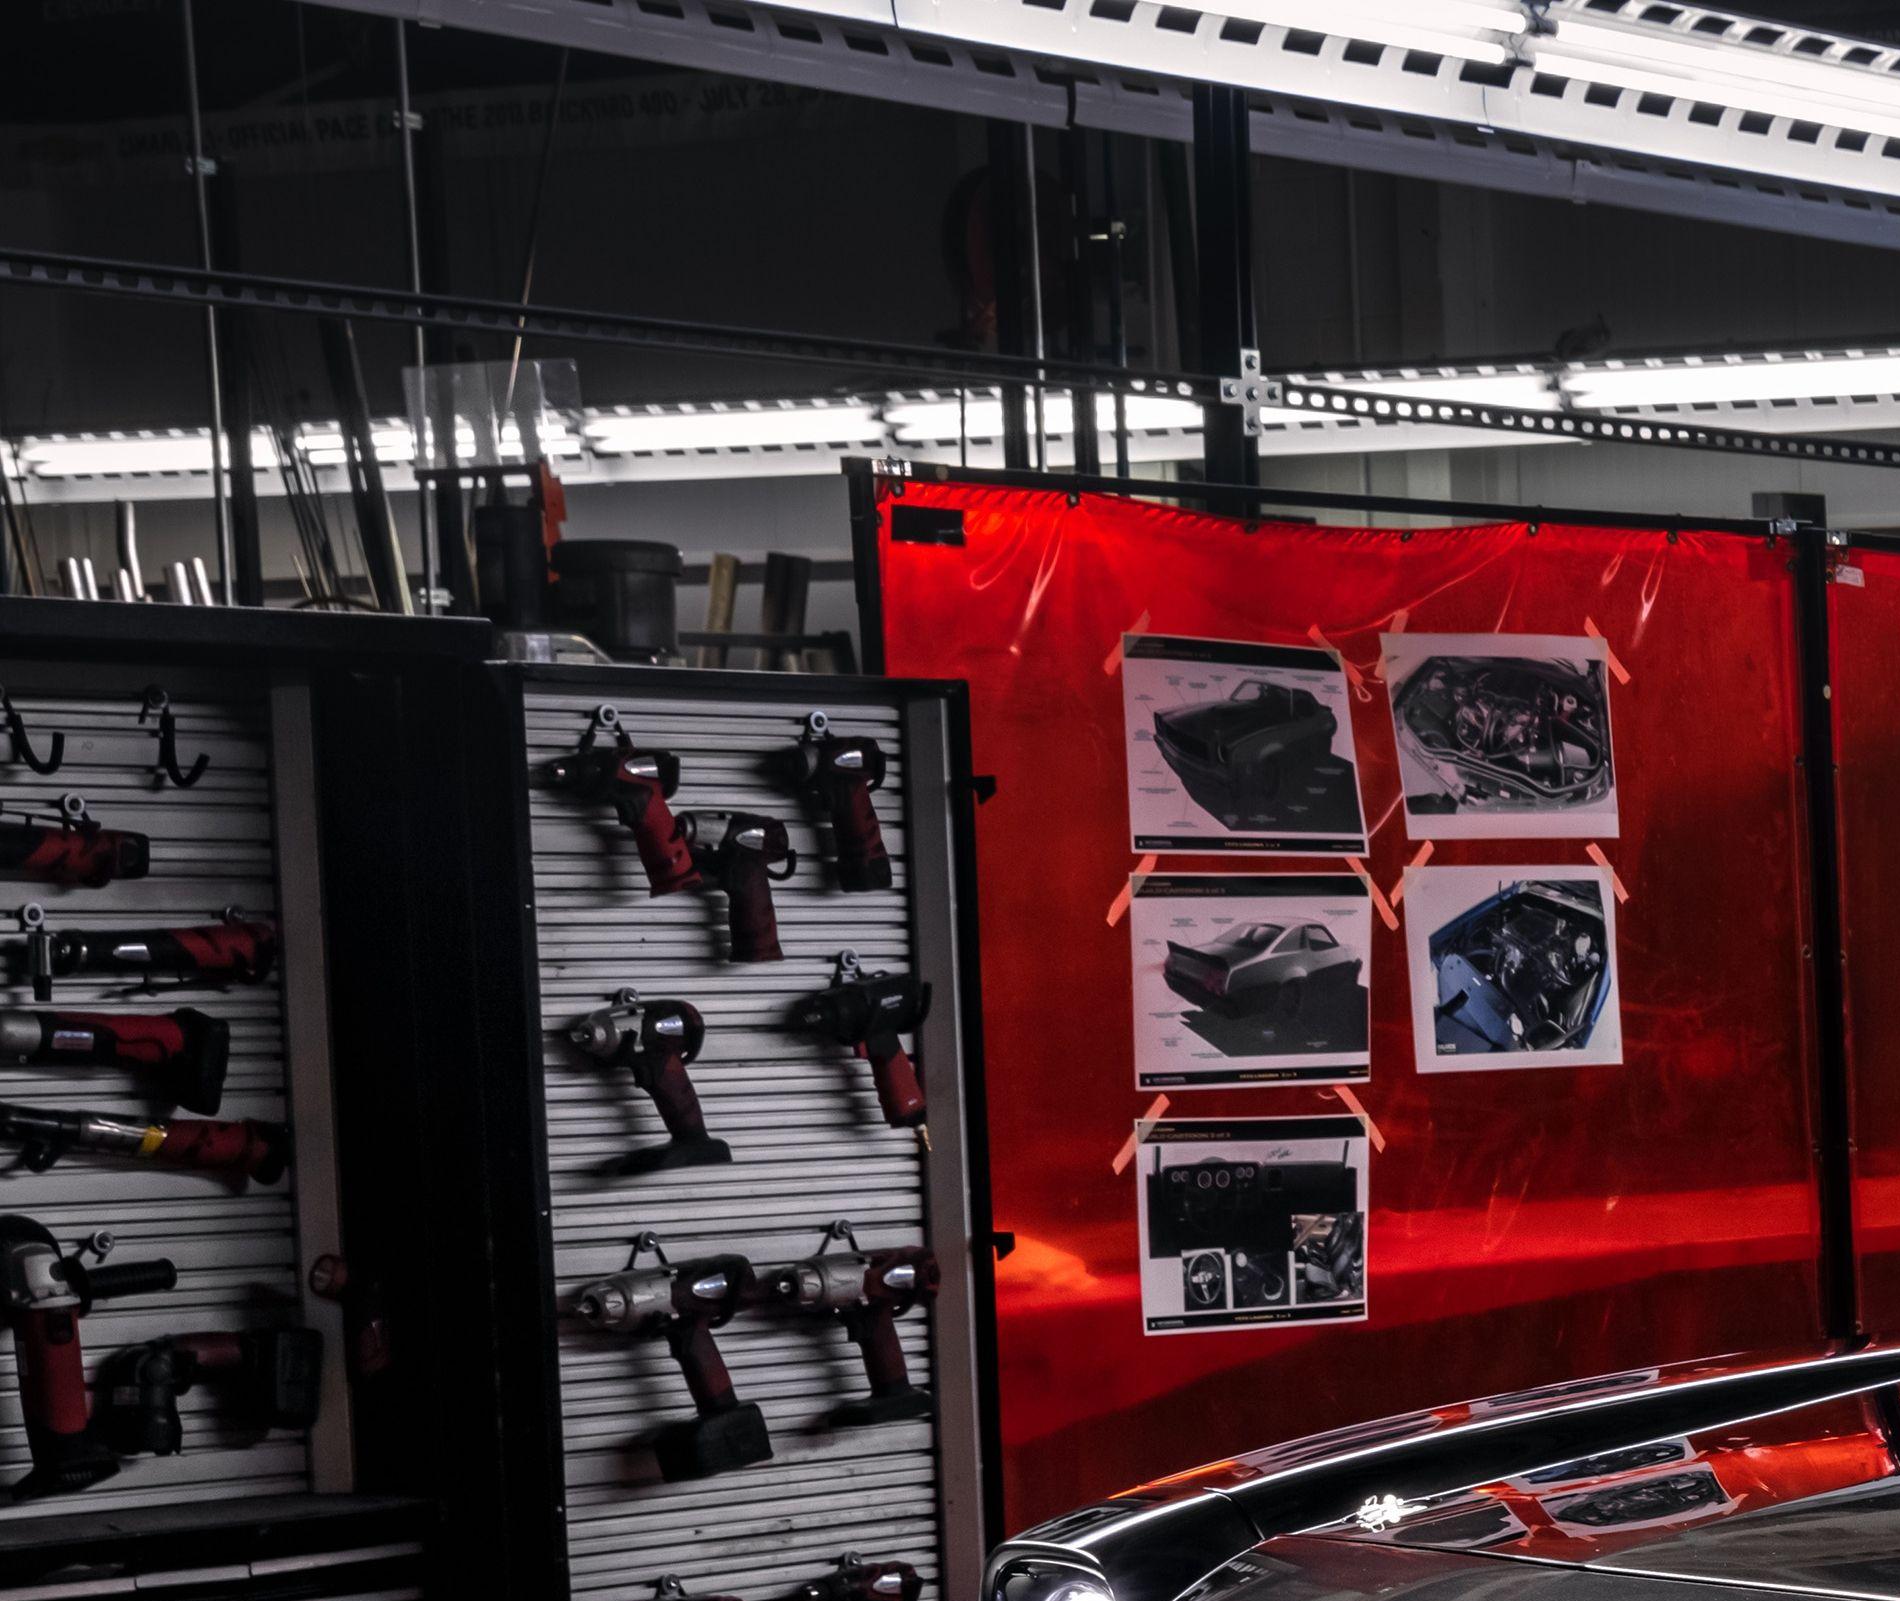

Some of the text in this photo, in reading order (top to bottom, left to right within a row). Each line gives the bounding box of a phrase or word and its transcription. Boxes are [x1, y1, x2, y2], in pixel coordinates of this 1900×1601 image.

[227, 120, 308, 150] OFFICIAL
[315, 113, 370, 143] PACE
[638, 90, 678, 117] 400
[698, 83, 750, 114] JULY
